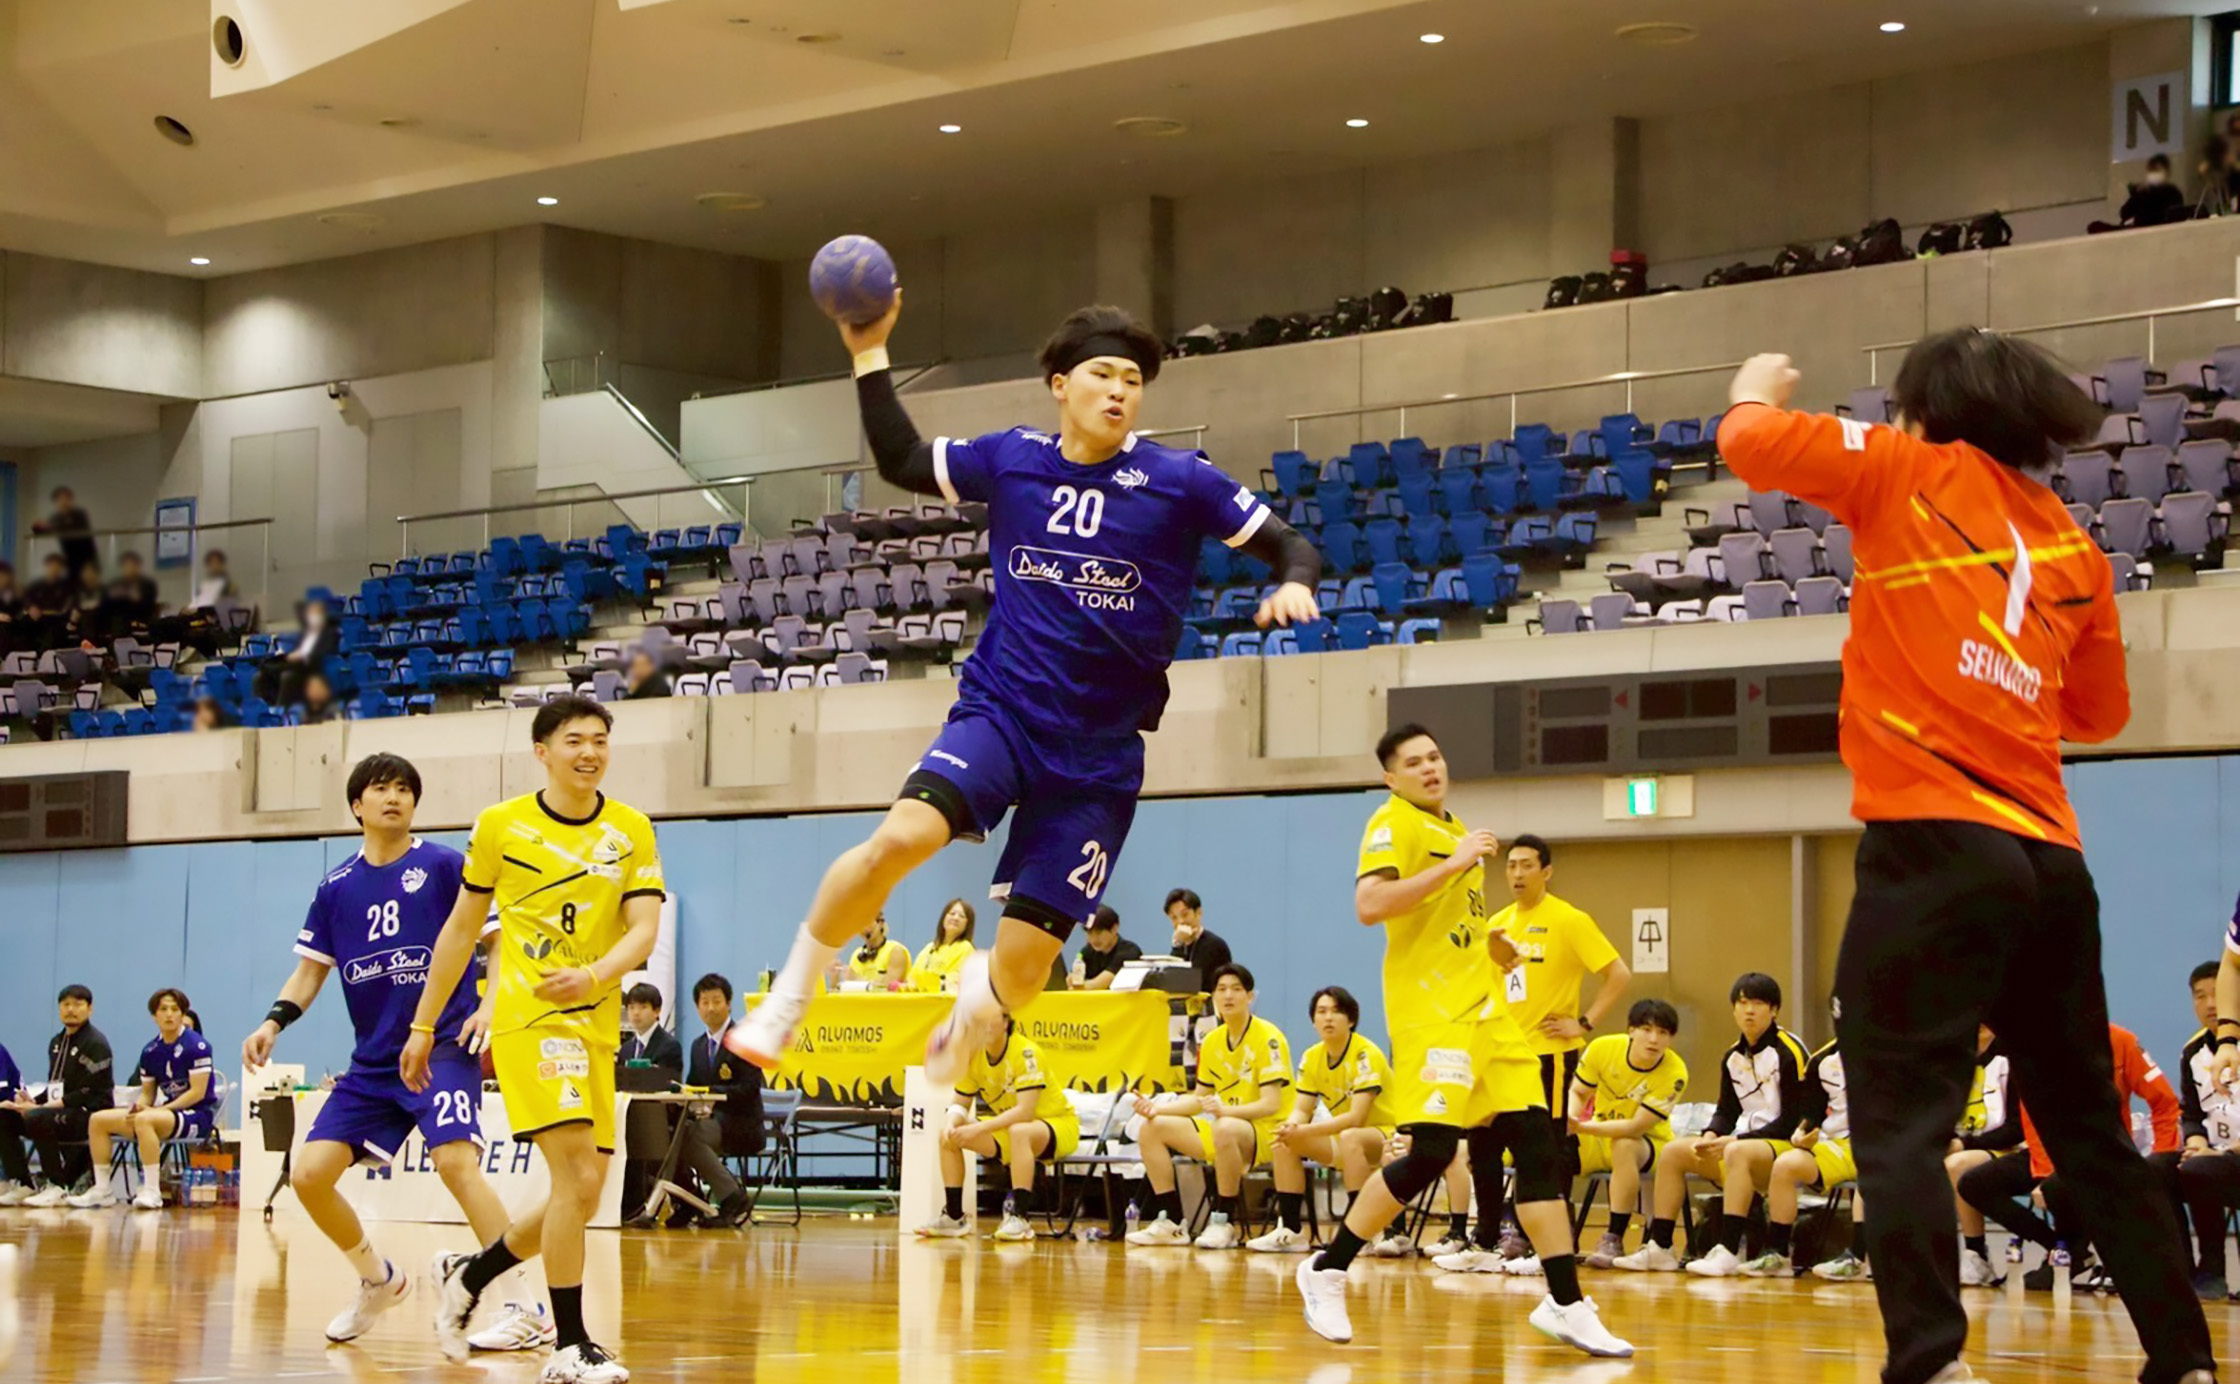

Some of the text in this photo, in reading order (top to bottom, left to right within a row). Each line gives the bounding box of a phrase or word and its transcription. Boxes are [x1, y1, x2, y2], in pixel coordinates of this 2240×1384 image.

[2126, 84, 2169, 150] N
[1047, 485, 1105, 538] 20
[1016, 552, 1133, 588] Daido Steel
[1076, 591, 1134, 611] TOKAI
[1066, 840, 1107, 899] 20
[367, 900, 399, 942] 28
[561, 902, 576, 935] 8
[391, 972, 428, 985] TOKA
[1510, 974, 1522, 991] A
[817, 1026, 883, 1042] ALVAMOS
[1033, 1021, 1100, 1040] ALVAMOS
[51, 1088, 58, 1099] C
[433, 1090, 471, 1127] 28
[2217, 1122, 2230, 1139] B
[404, 1139, 532, 1174] LEE H
